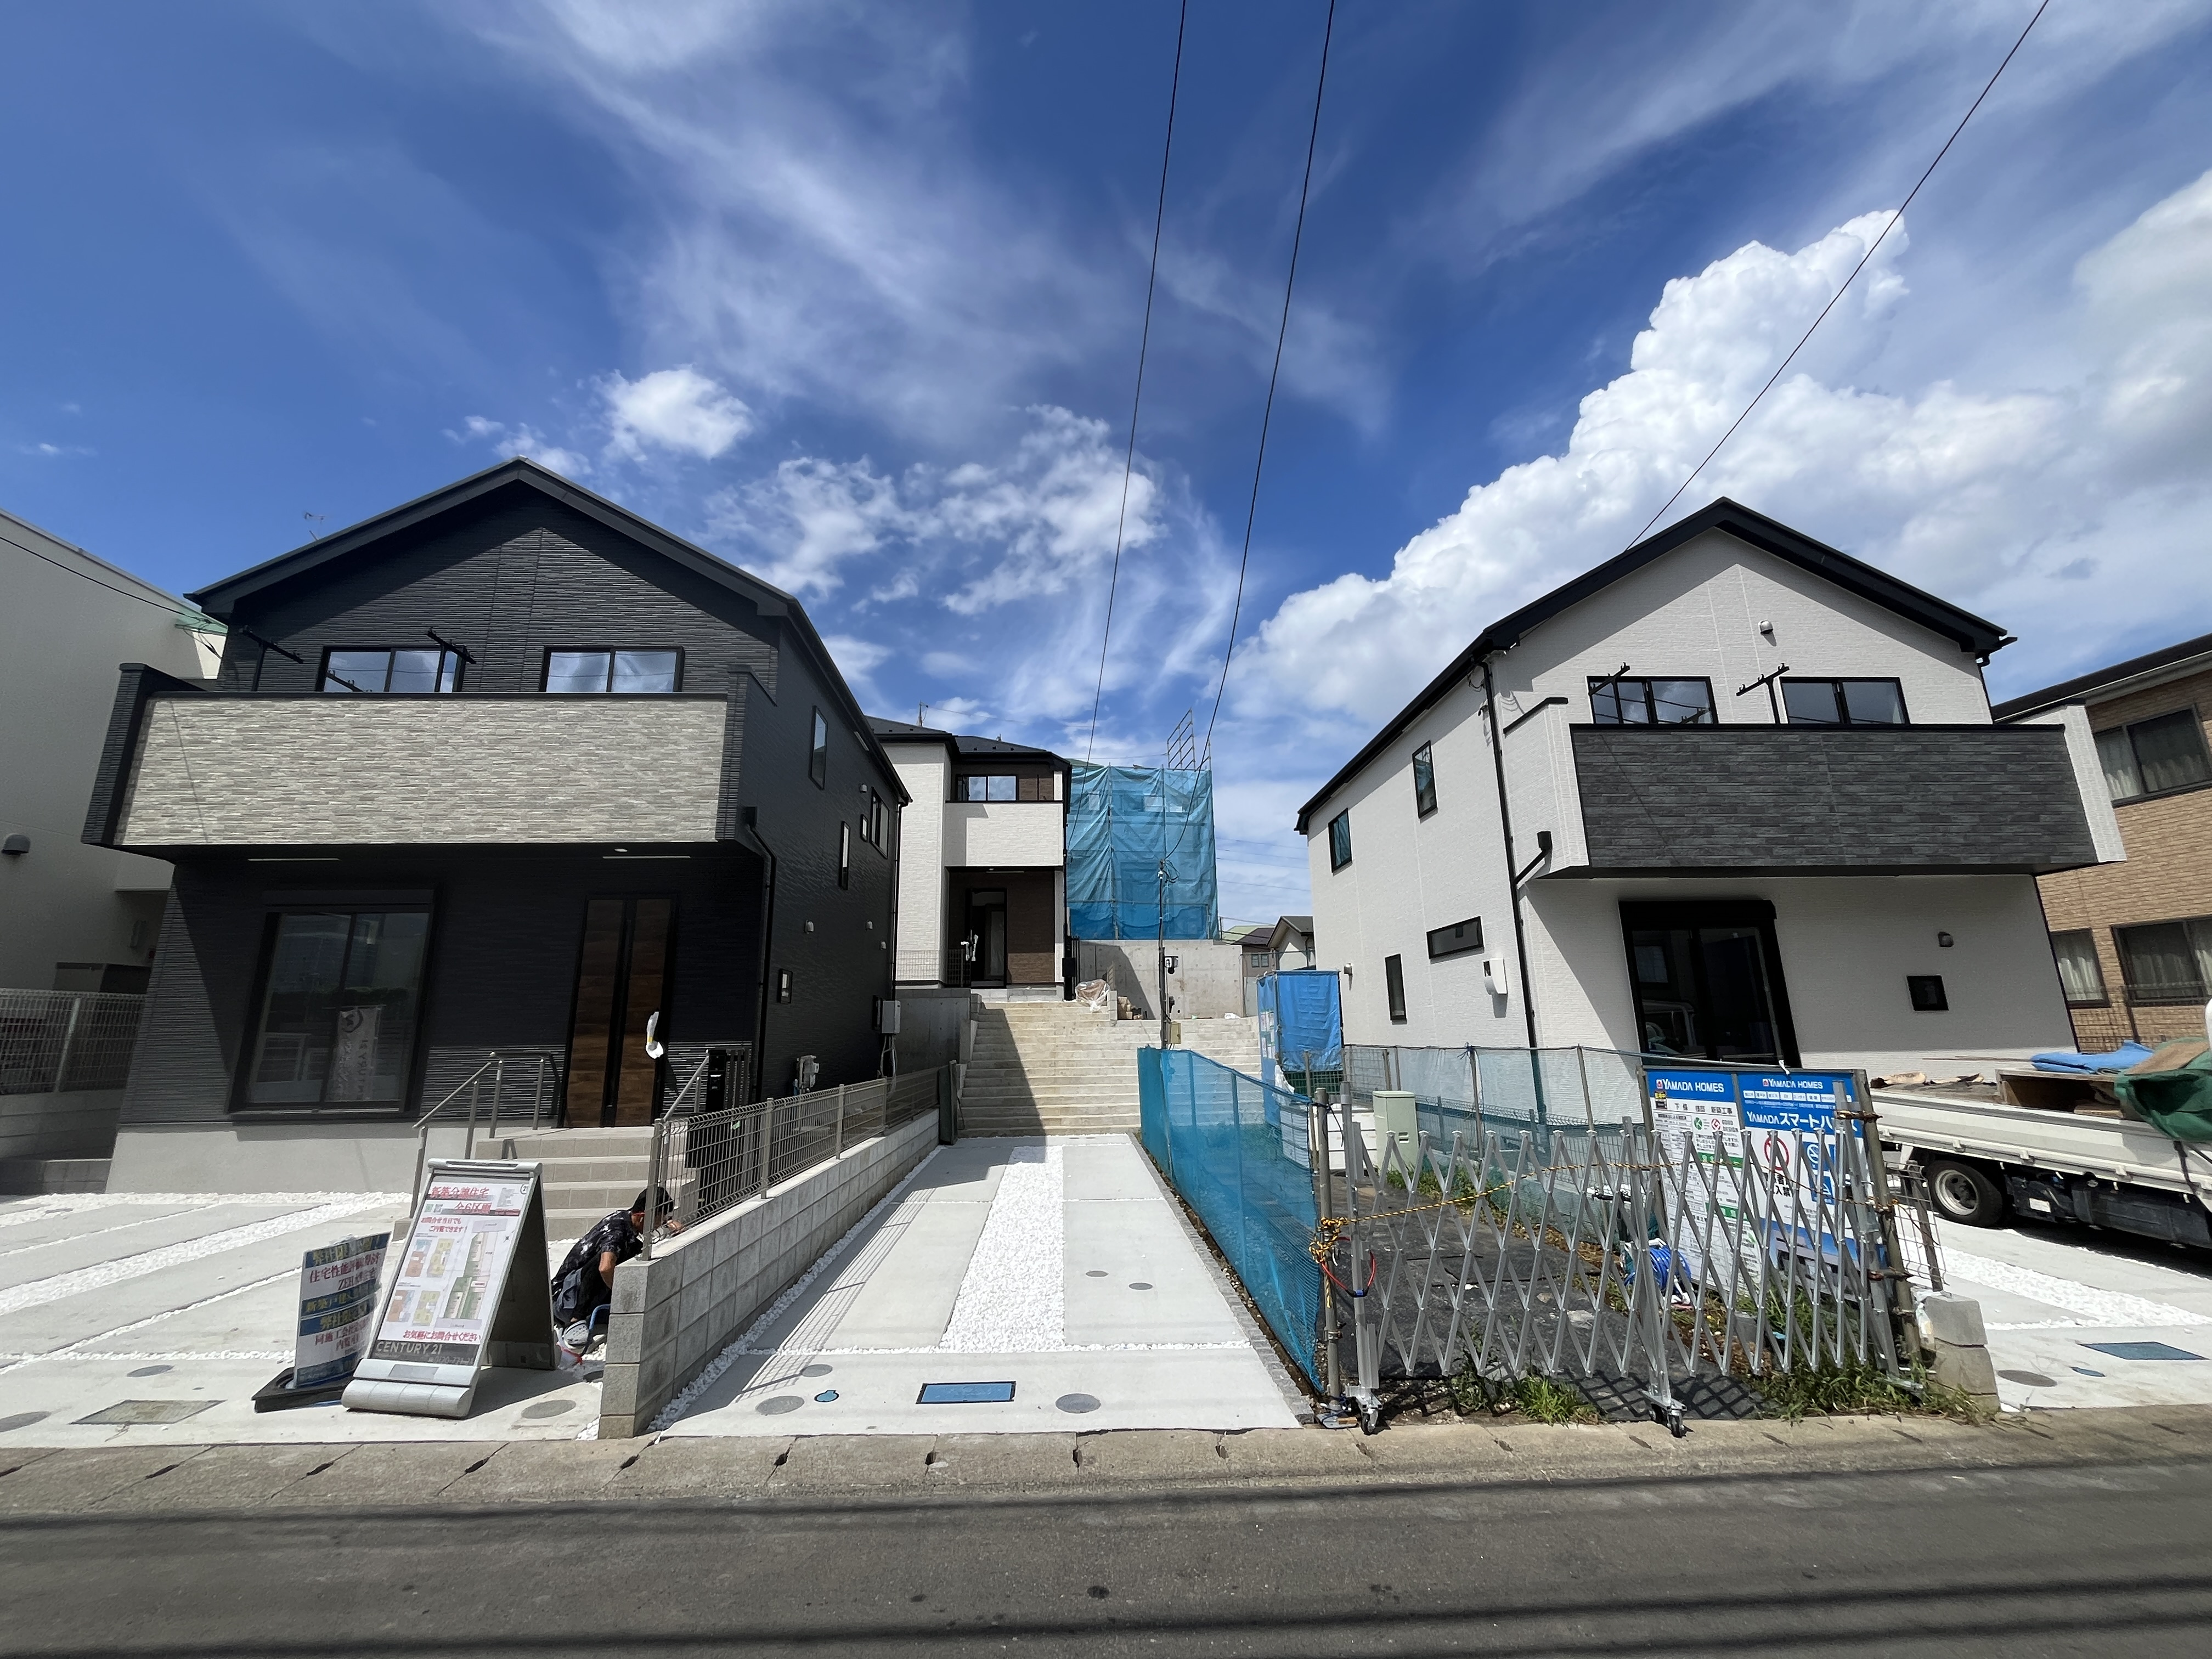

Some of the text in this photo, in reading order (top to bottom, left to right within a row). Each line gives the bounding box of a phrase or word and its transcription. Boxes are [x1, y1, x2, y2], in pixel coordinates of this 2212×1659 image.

[1662, 1079, 1724, 1093] YAMADA HOMES
[1768, 1079, 1823, 1090] YAMADA HOMES
[430, 1186, 489, 1199] 新築分譲住宅
[376, 1341, 430, 1355] CENTURY
[431, 1344, 443, 1355] 21
